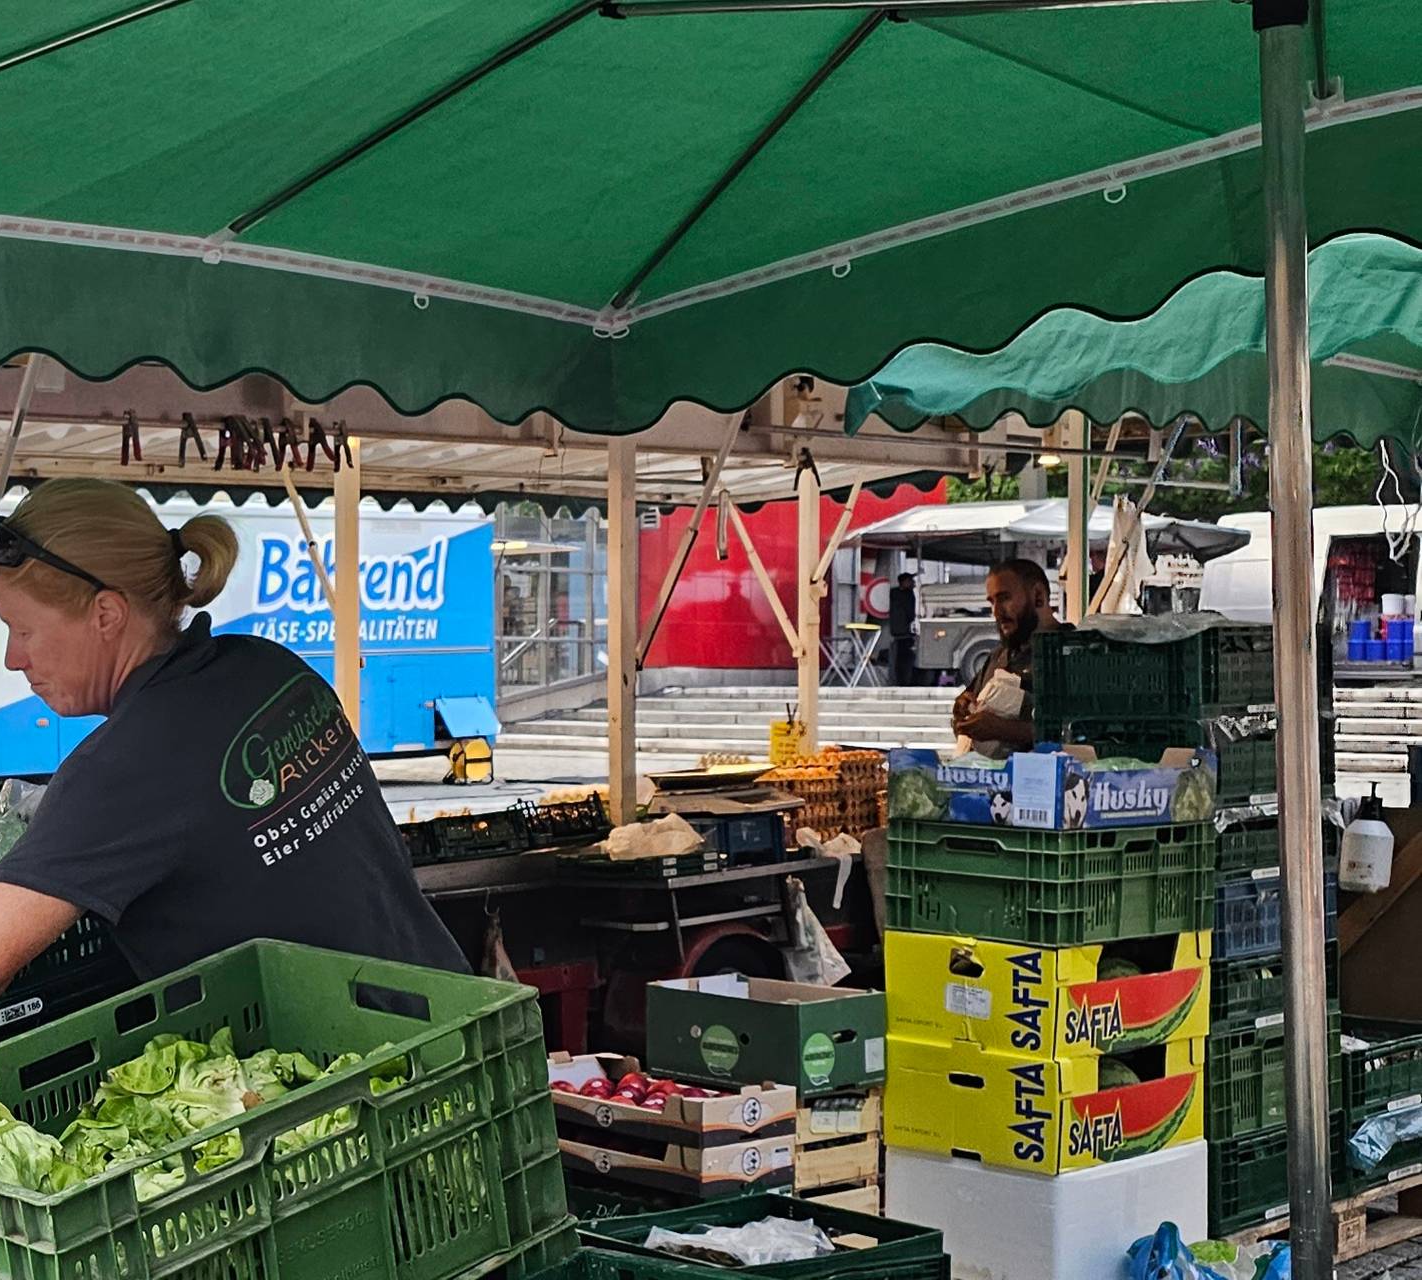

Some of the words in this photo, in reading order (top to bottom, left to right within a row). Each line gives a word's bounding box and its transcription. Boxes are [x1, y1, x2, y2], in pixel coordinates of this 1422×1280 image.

[252, 616, 438, 643] KÄSE-SPEALITÄTEN
[253, 817, 298, 849] Obst
[300, 779, 341, 820] Gemüse
[261, 838, 301, 868] Eier
[305, 783, 365, 843] Südfrüchte
[1093, 779, 1170, 817] Husky
[1005, 950, 1050, 1051] SAFTA
[1065, 994, 1123, 1048] SAFTA
[1007, 1063, 1053, 1163] SAFTA
[1069, 1106, 1123, 1159] SAFTA
